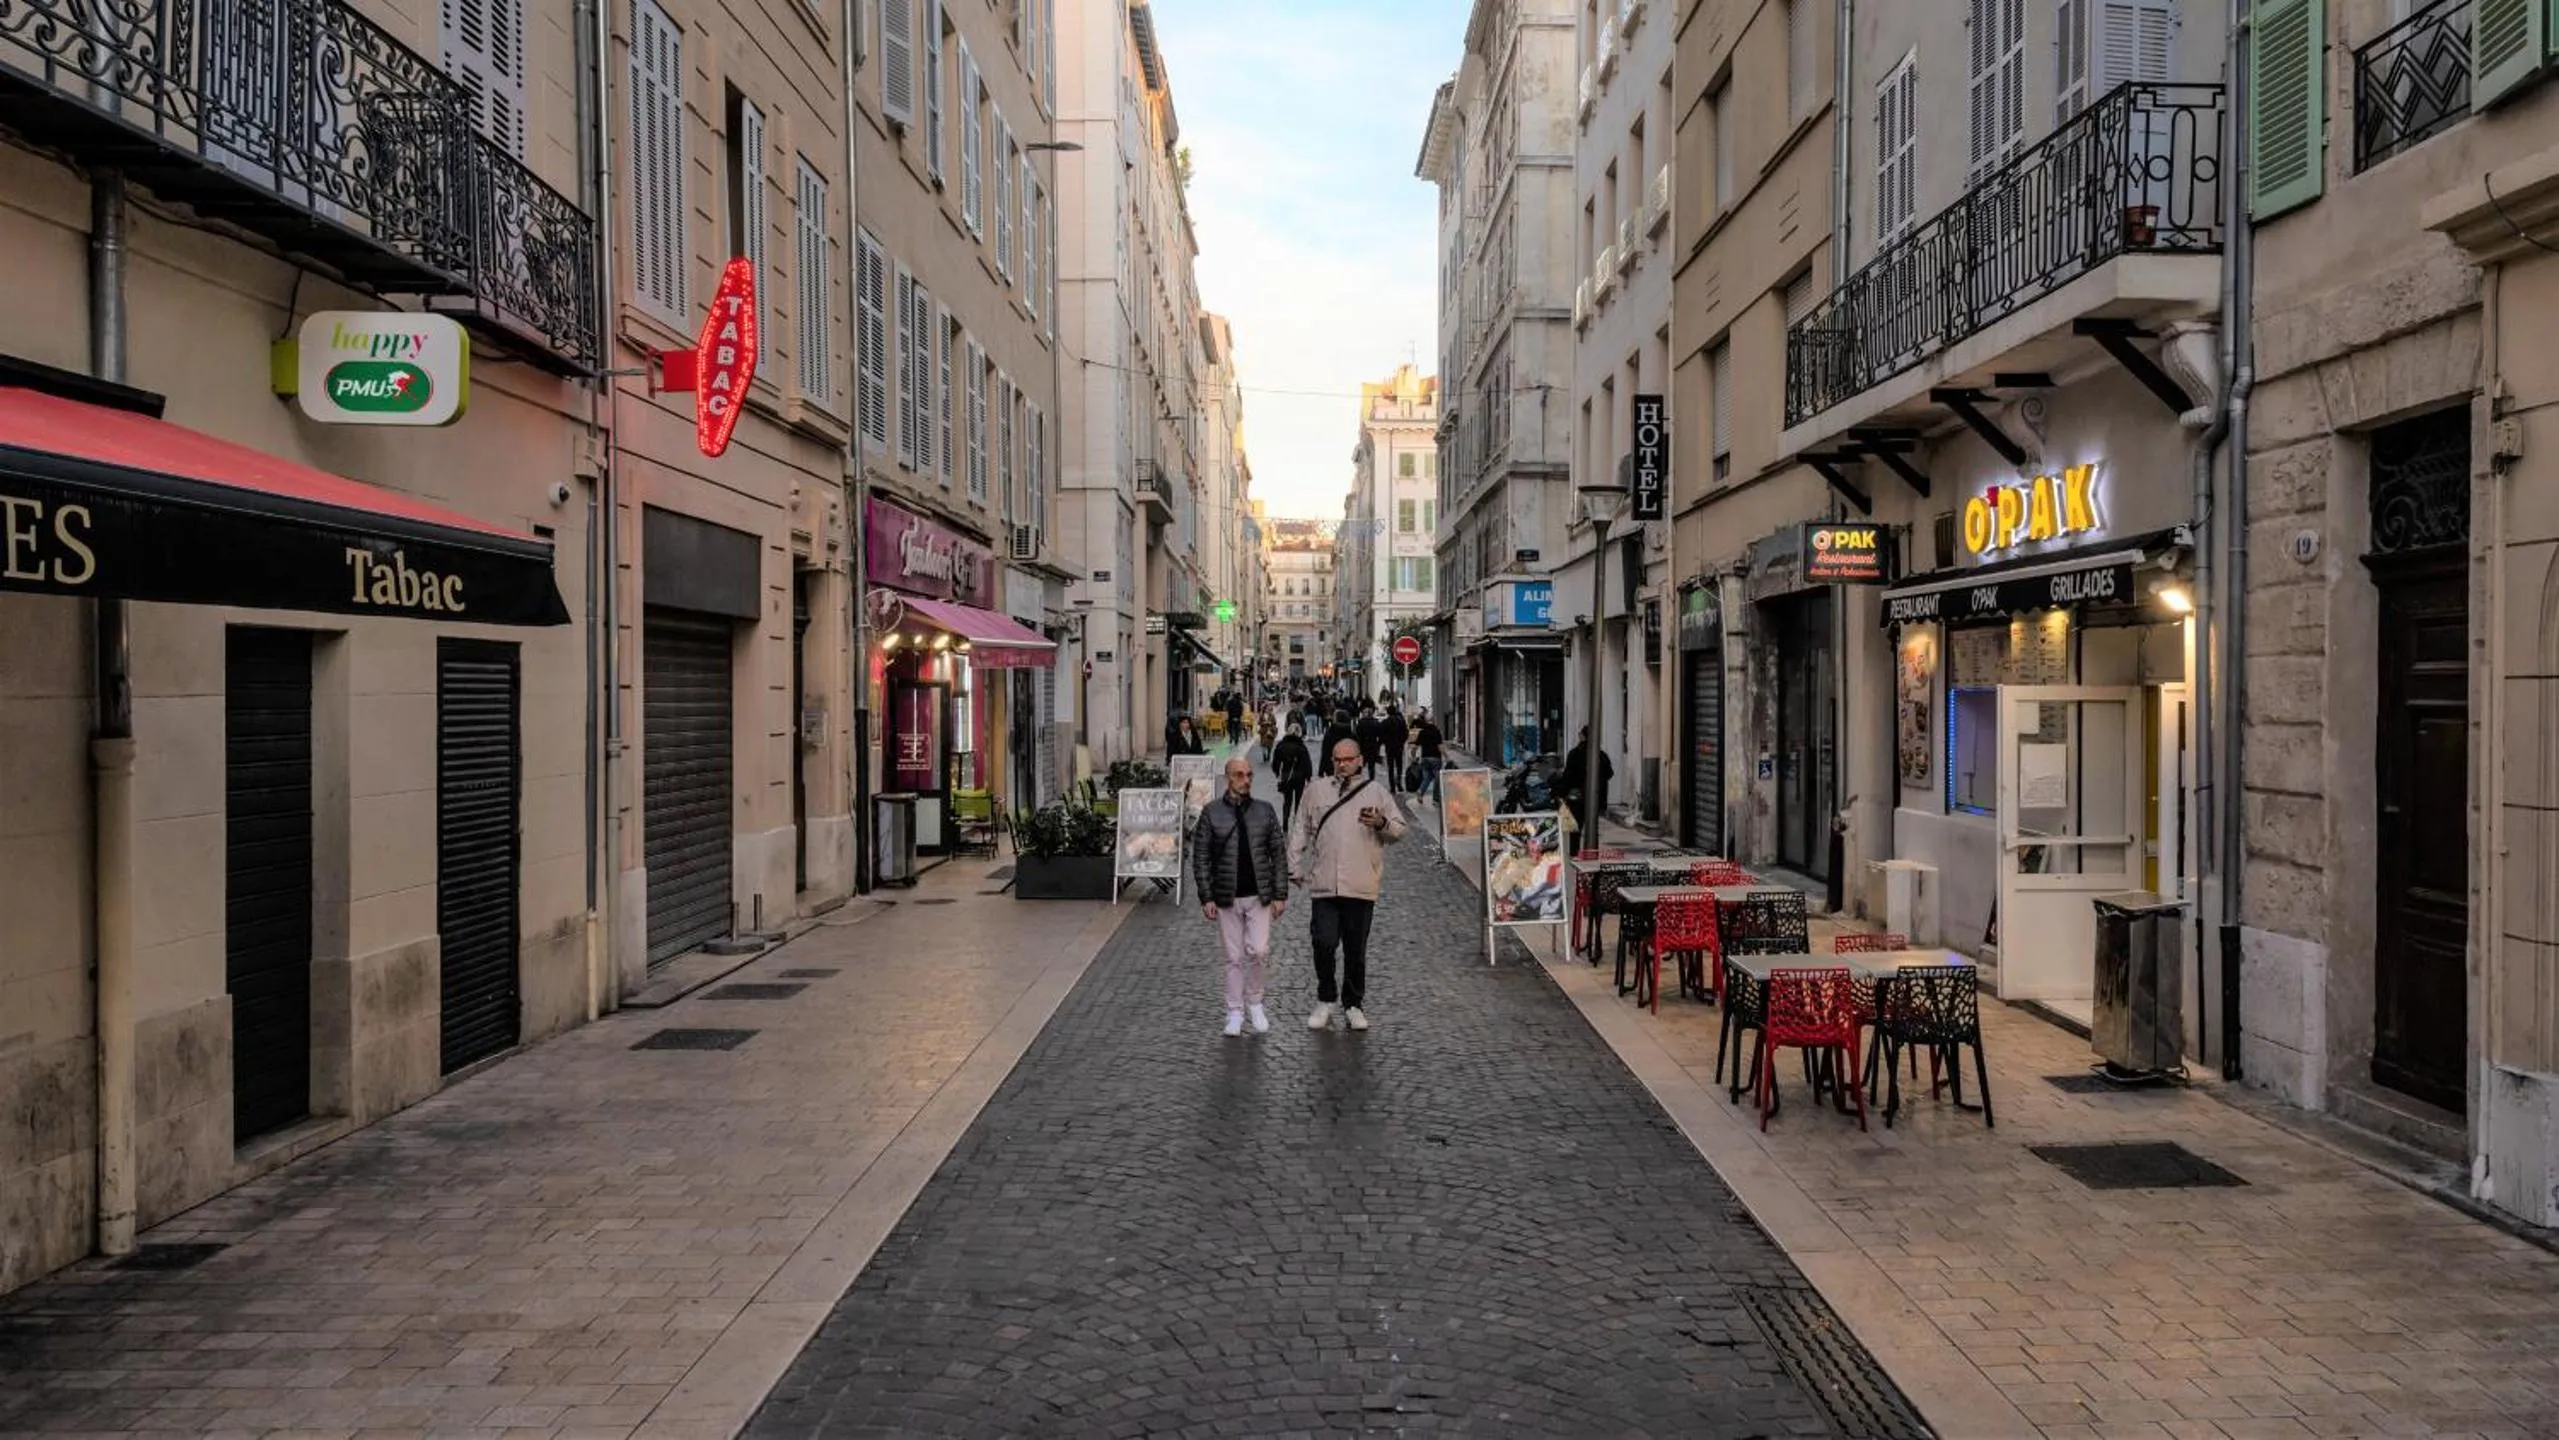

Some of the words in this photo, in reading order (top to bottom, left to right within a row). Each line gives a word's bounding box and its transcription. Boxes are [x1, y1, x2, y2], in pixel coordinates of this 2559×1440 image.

[330, 320, 428, 359] happy
[708, 296, 742, 416] TABAC
[336, 379, 384, 397] PMU
[1637, 403, 1661, 511] HOTEL
[1964, 463, 2102, 554] O'PAK
[0, 495, 96, 584] ES
[1812, 529, 1877, 551] O'PAK
[2296, 536, 2311, 556] 19
[345, 547, 466, 612] Tabac
[1890, 593, 1941, 619] RESTAURANT
[2050, 568, 2115, 602] GRILLADES
